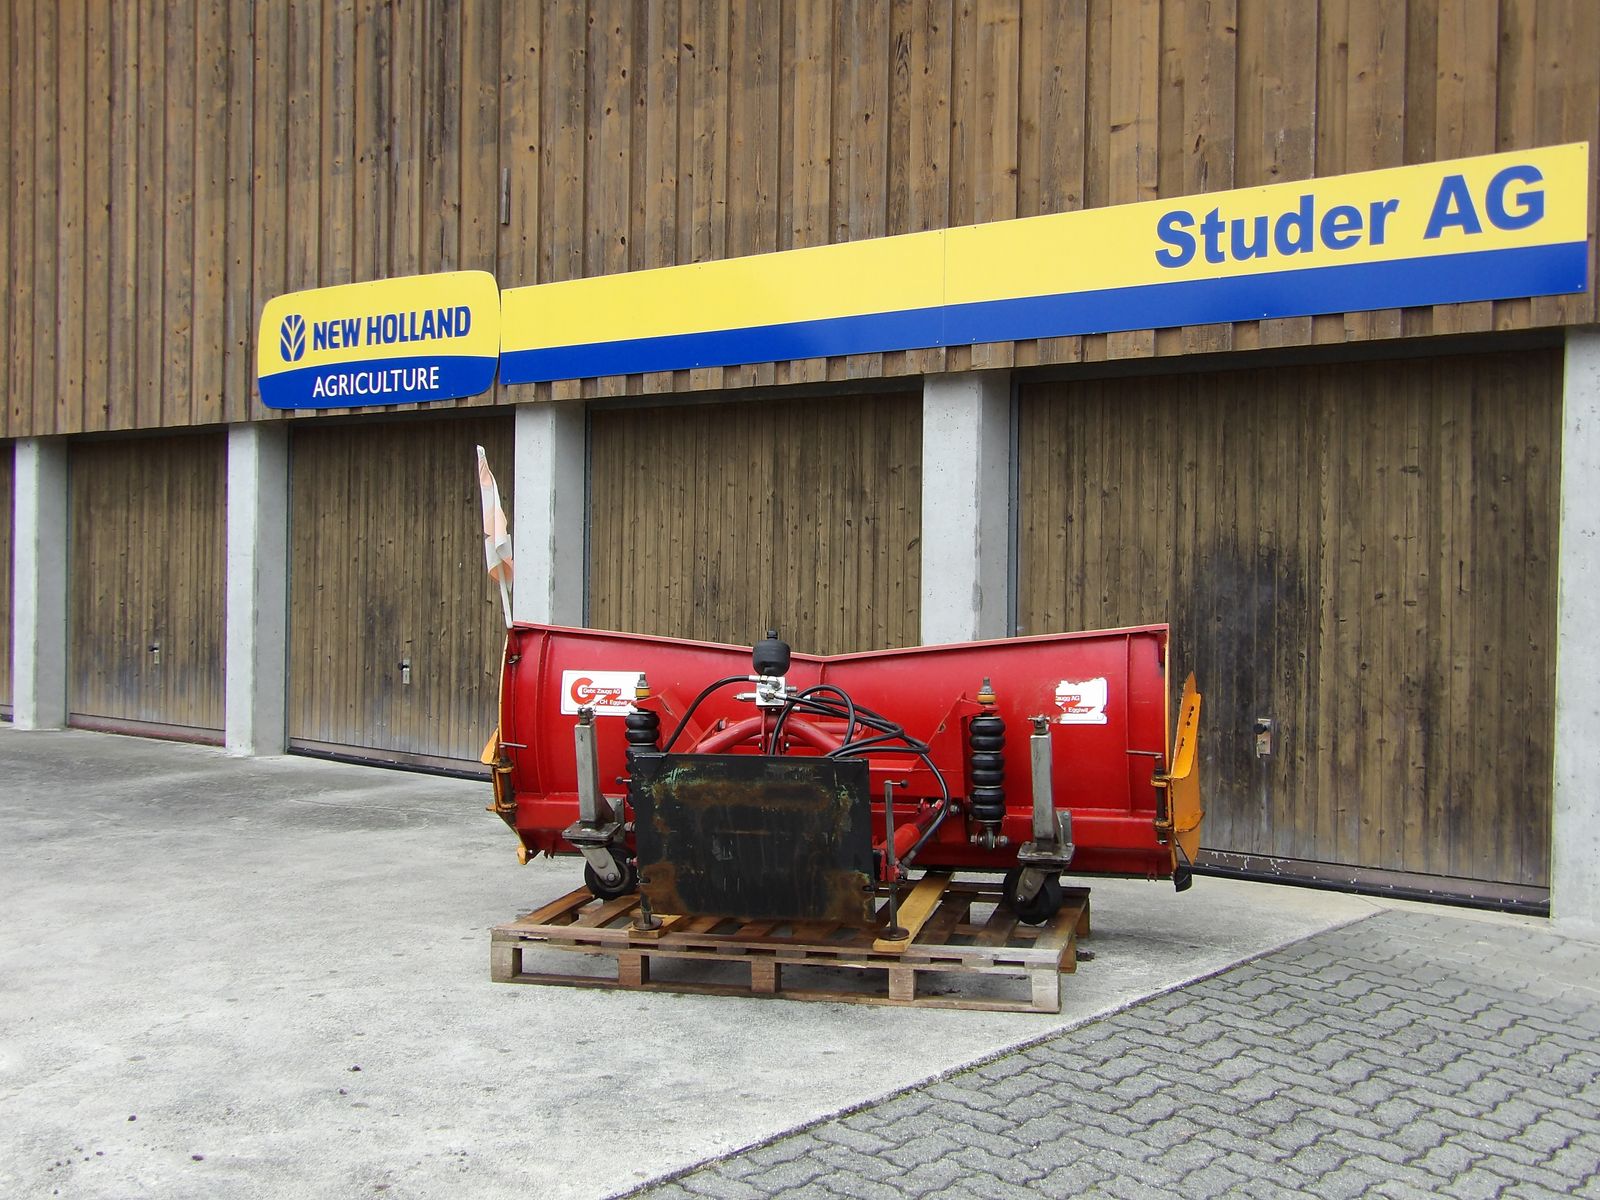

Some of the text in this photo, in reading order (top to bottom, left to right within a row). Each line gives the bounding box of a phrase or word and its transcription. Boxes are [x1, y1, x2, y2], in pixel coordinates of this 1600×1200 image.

[1154, 164, 1545, 269] Studer AG
[313, 305, 472, 351] NEW HOLLAND
[312, 366, 440, 398] AGRICULTURE
